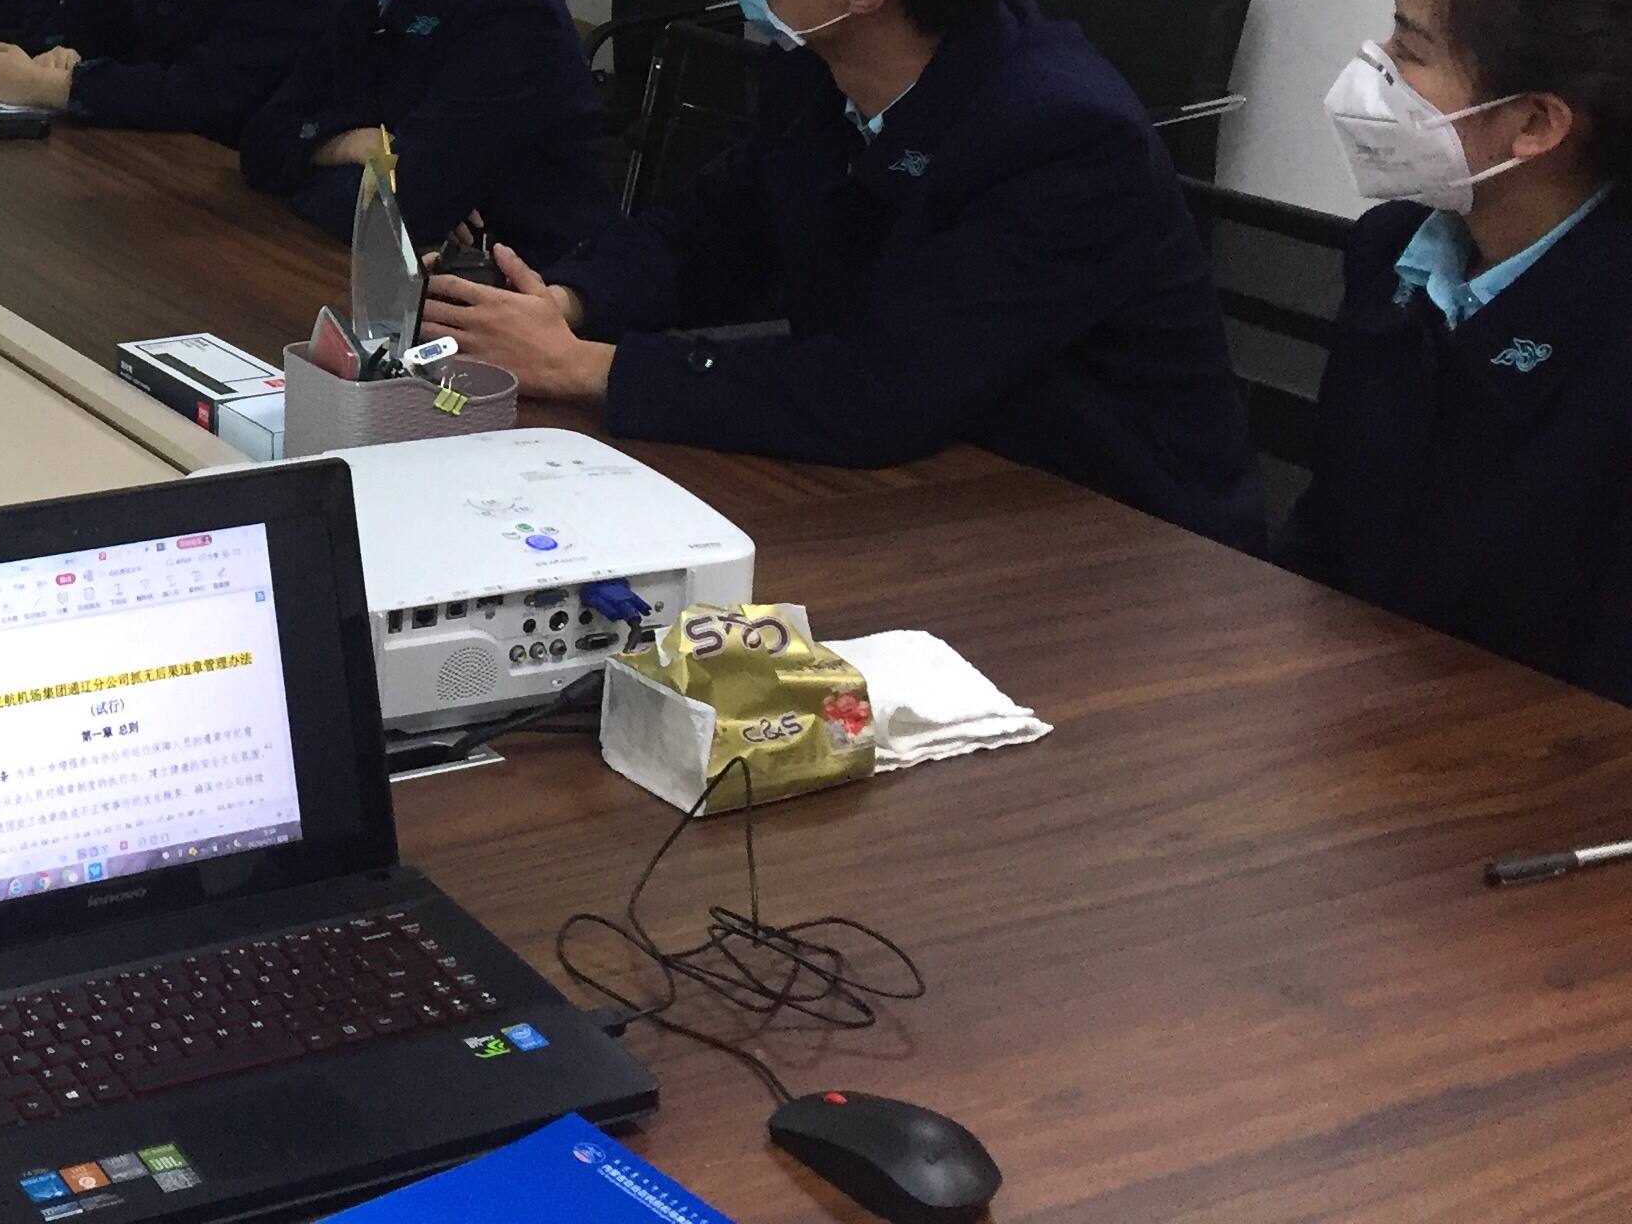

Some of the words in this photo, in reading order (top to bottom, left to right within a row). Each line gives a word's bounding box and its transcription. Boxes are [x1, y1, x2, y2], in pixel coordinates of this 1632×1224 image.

[81, 726, 113, 743] 第一章
[742, 712, 804, 743] C&S
